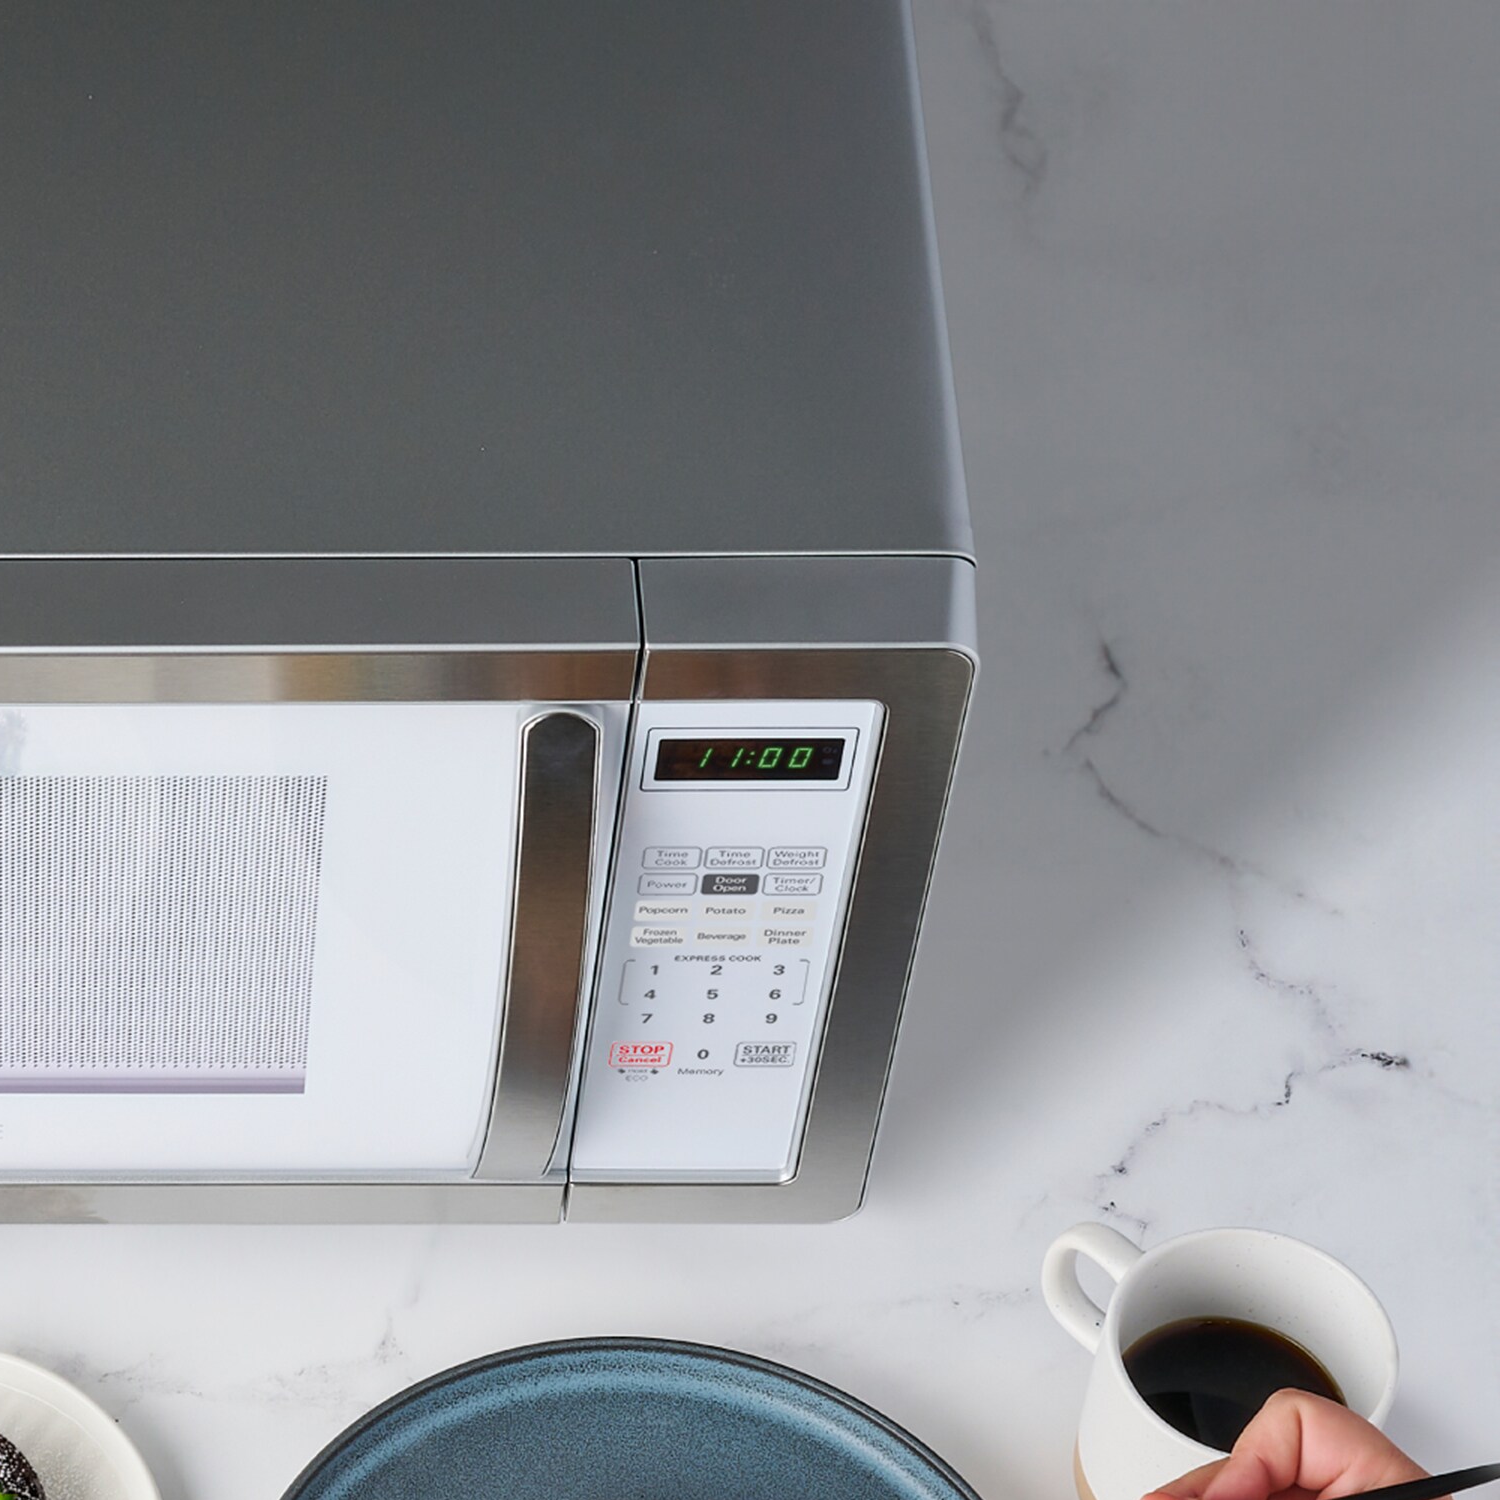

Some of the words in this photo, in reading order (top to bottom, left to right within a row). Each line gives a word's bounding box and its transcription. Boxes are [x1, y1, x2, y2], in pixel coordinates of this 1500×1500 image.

[775, 851, 820, 859] Weight
[655, 858, 687, 866] Cook
[710, 858, 757, 866] Defrost
[773, 858, 819, 866] Defrost
[647, 880, 687, 888] Power
[713, 884, 747, 892] Open
[638, 907, 688, 915] Popcorn
[705, 907, 746, 915] Potato
[773, 907, 805, 915] Pizza
[697, 933, 746, 941] Beverage
[764, 929, 807, 937] Dinner
[635, 937, 683, 945] Vegetable
[768, 937, 801, 945] Plate
[651, 965, 659, 975] 1
[710, 965, 723, 975] 2
[773, 965, 785, 975] 3
[644, 989, 656, 999] 4
[707, 989, 719, 999] 5
[769, 989, 781, 999] 6
[641, 1013, 653, 1024] 7
[703, 1013, 715, 1024] 8
[765, 1013, 778, 1024] 9
[619, 1045, 665, 1055] STOP
[697, 1049, 710, 1059] 0
[743, 1045, 791, 1055] START
[677, 1068, 724, 1076] Memory
